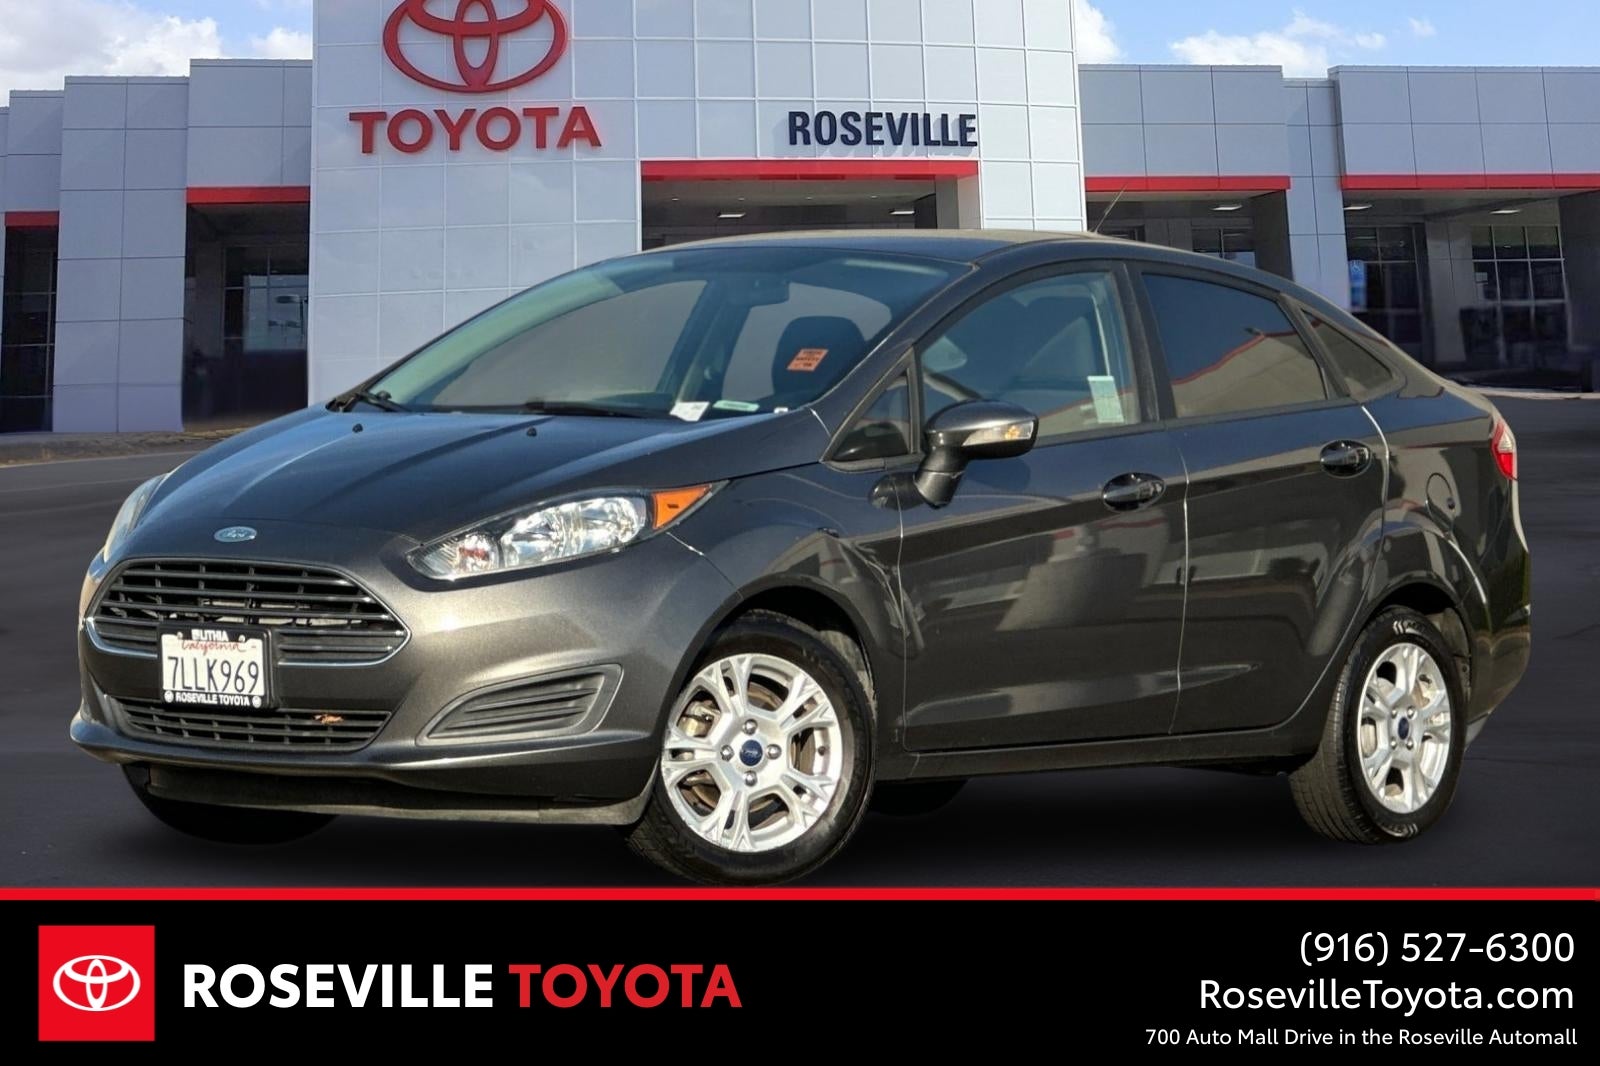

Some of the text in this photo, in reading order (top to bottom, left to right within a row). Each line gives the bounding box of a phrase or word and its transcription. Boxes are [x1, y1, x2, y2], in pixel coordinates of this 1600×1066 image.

[349, 106, 602, 154] TOYOTA
[788, 110, 979, 147] ROSEVILLE
[167, 656, 260, 694] 7LLK969
[175, 692, 251, 707] ROSEVILLE TOYOTA
